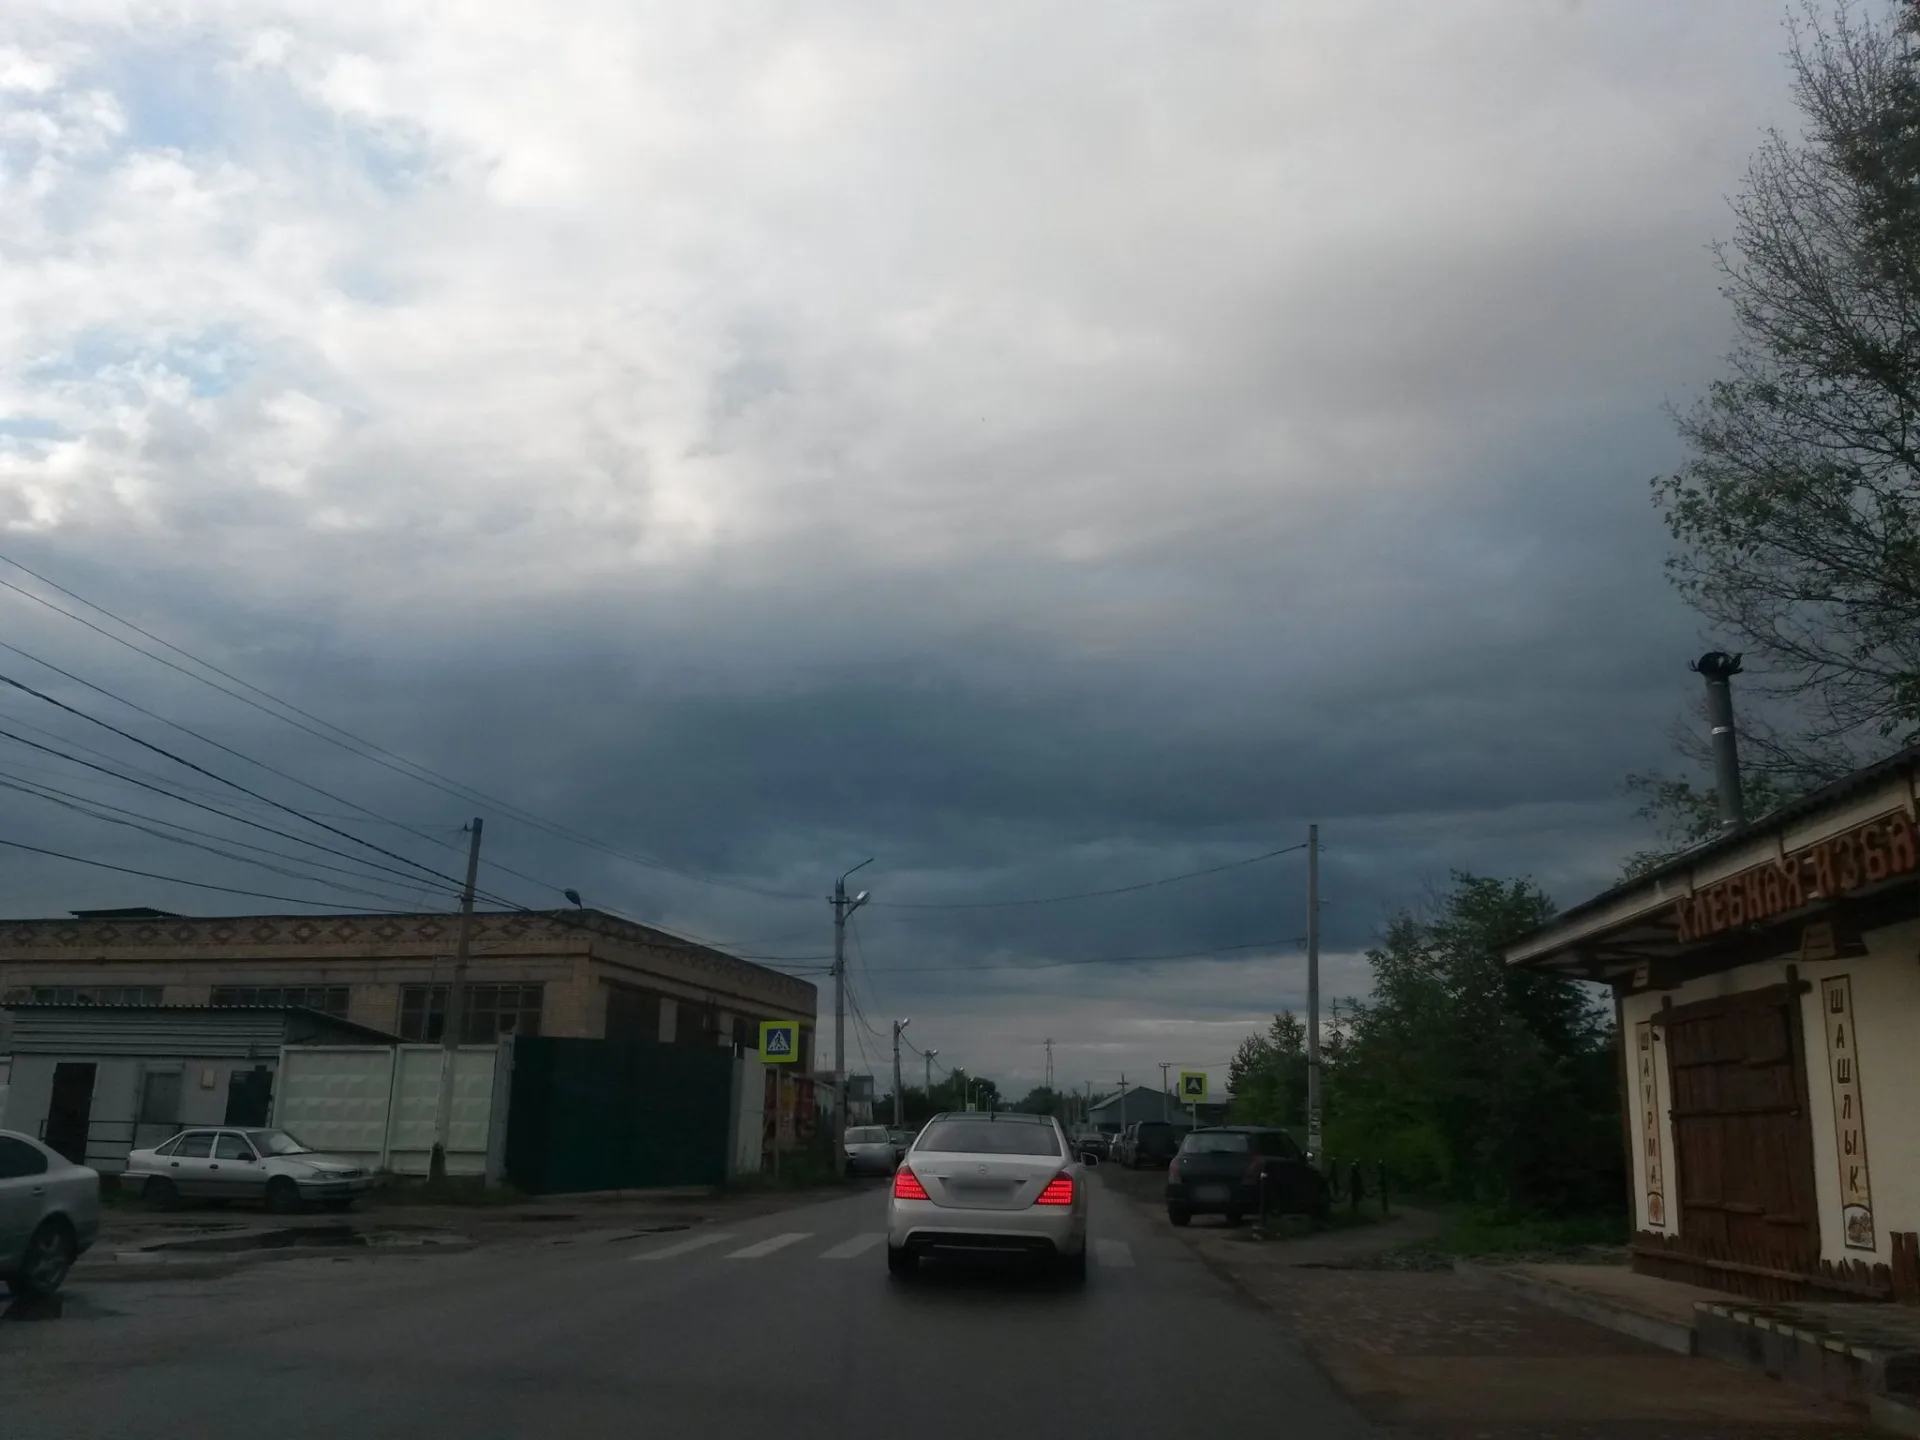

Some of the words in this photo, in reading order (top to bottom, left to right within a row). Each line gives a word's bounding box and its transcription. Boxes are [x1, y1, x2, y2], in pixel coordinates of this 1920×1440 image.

[1675, 855, 1804, 943] ХЛЕБНАЯ
[1812, 812, 1916, 898] ИЗБА
[1640, 1032, 1657, 1184] ШАУРМА
[1830, 988, 1859, 1192] ШАШЛЫК
